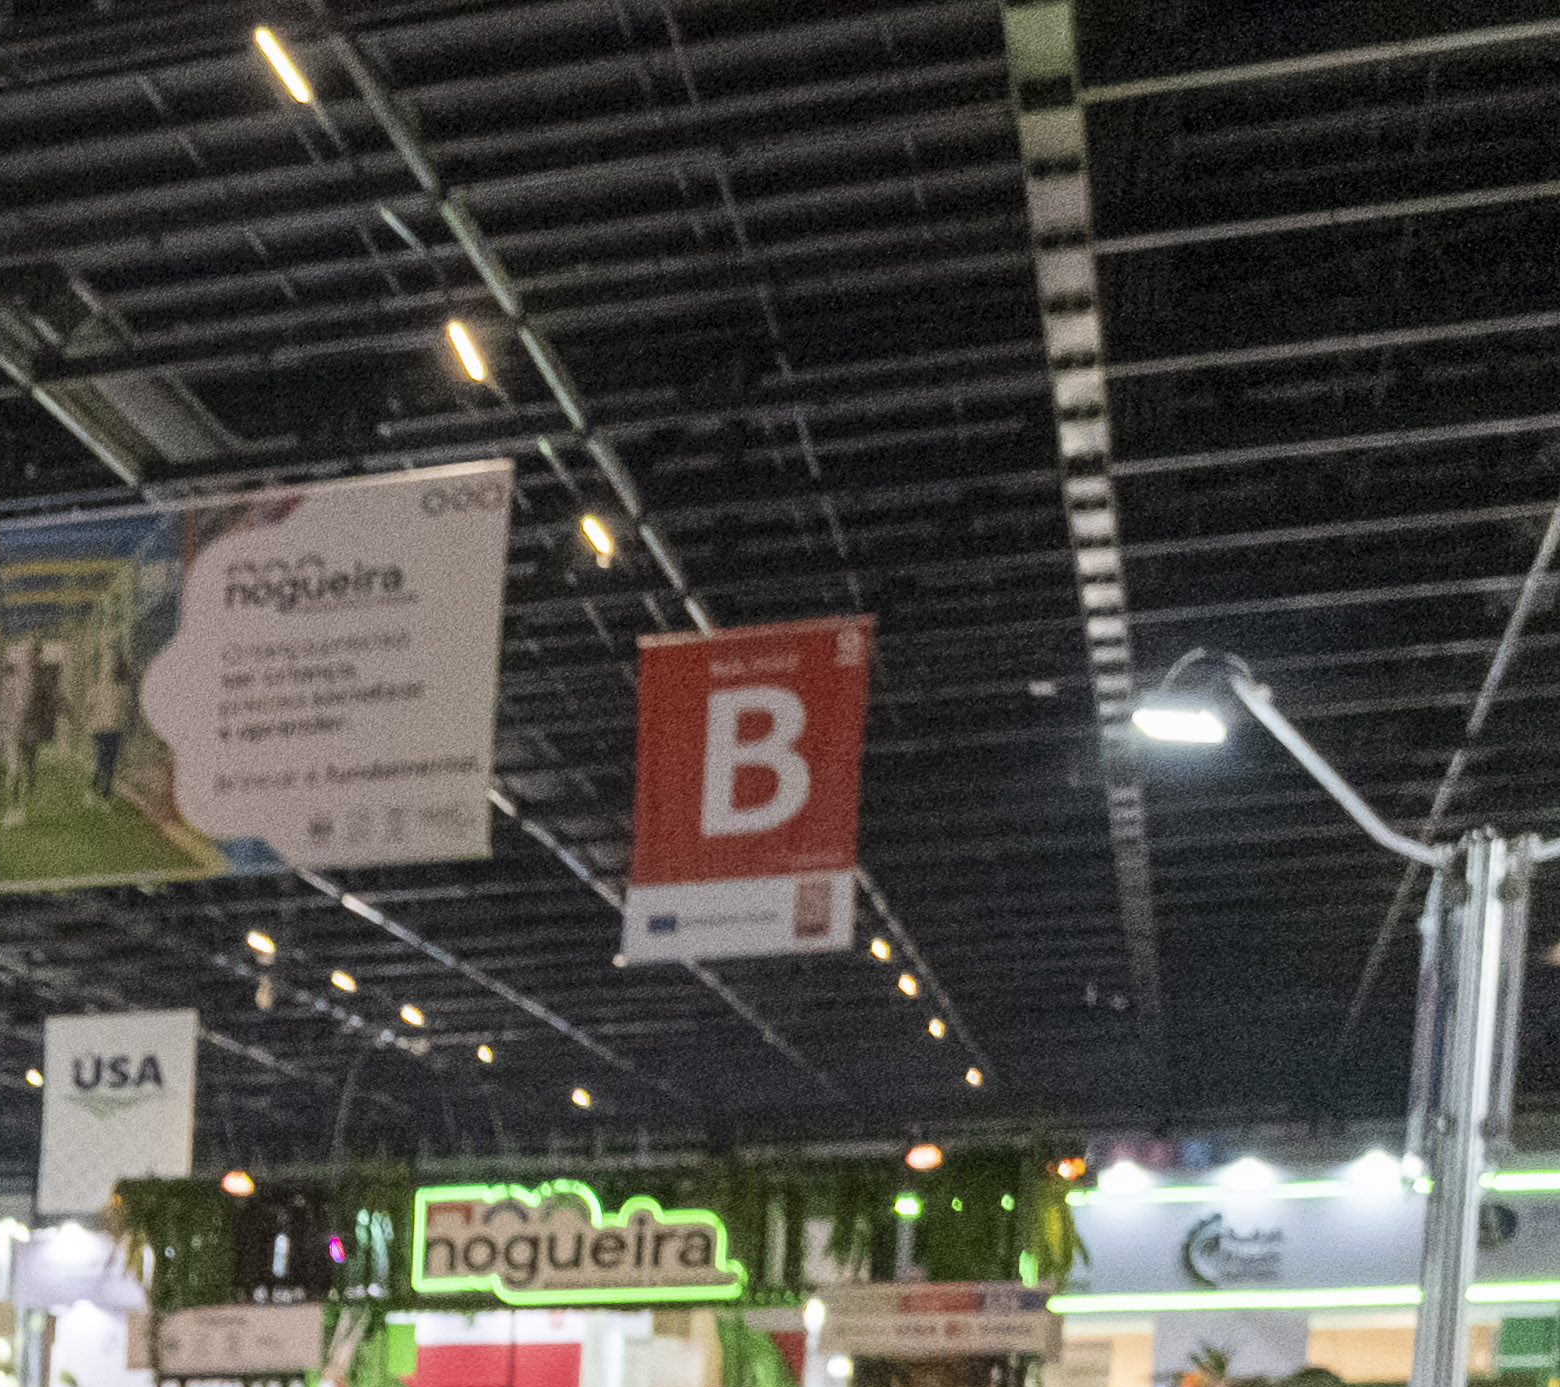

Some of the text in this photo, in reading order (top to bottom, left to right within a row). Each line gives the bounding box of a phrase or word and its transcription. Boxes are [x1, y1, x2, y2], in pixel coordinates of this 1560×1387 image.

[225, 561, 404, 614] nogueira
[700, 686, 810, 838] B
[71, 1052, 165, 1095] USA
[425, 1214, 713, 1291] nogueira
